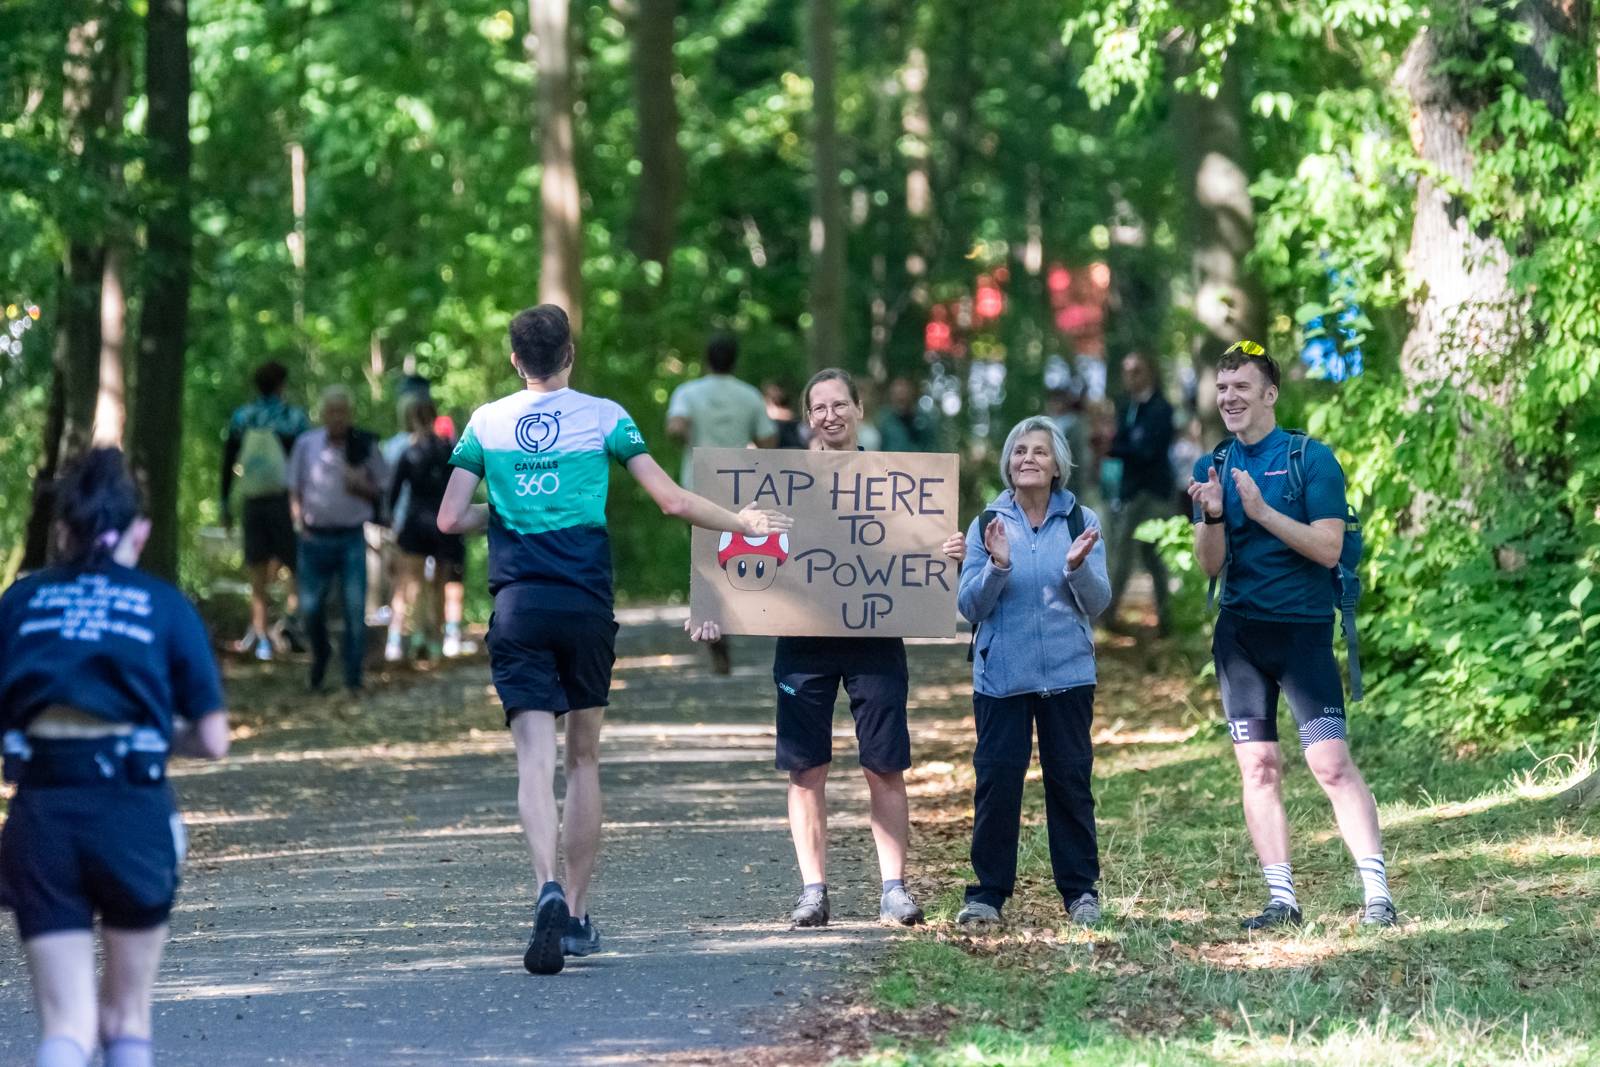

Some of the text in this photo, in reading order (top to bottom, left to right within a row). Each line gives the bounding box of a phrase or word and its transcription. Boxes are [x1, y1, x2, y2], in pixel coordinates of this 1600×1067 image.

[514, 460, 559, 471] CAVALLS
[716, 469, 946, 516] TAP HERE
[838, 514, 886, 546] TO
[793, 547, 951, 592] POWER
[841, 592, 894, 630] UP
[1323, 706, 1343, 715] GORE
